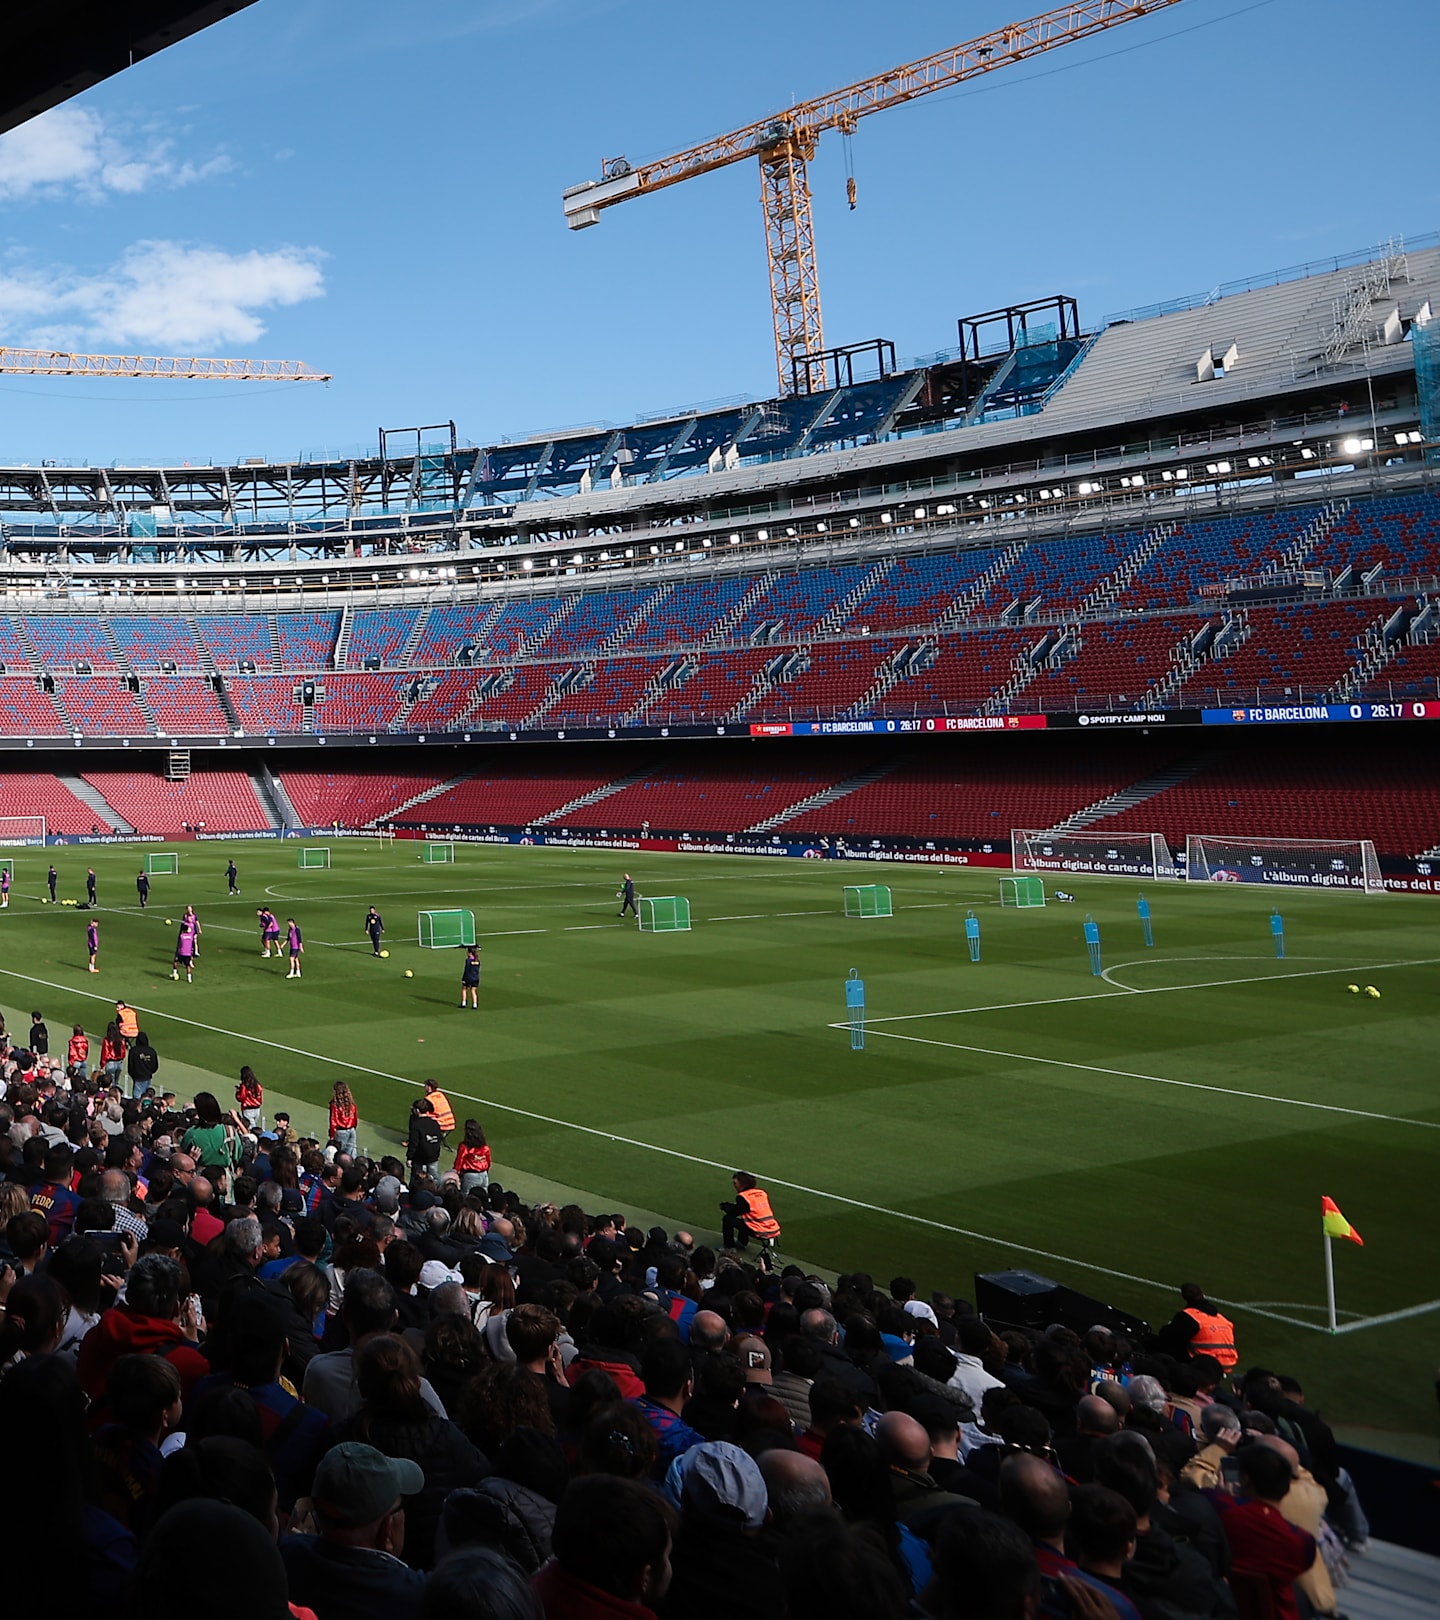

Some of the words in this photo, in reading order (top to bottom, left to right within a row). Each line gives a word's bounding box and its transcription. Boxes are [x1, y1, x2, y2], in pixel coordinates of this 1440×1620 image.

[1090, 715, 1122, 724] SPOTIFY
[1123, 714, 1146, 722] CAMP
[1147, 714, 1165, 722] NOU
[1249, 709, 1263, 721] FC
[1265, 706, 1329, 720] BARCELONA
[1350, 705, 1362, 718] 0
[1371, 704, 1403, 718] 26:17
[1413, 703, 1426, 717] 0
[822, 723, 832, 732] FC
[833, 721, 874, 732] BARCELONA
[887, 720, 895, 731] 0
[900, 720, 921, 731] 26:17
[926, 719, 935, 730] 0
[946, 719, 956, 729] FC
[957, 717, 1004, 729] BARCELONA
[568, 838, 585, 846] digital
[678, 843, 703, 851] L'àlbum
[704, 844, 724, 853] digital
[725, 844, 733, 852] de
[734, 845, 755, 853] cartes
[768, 847, 787, 855] Barça
[868, 851, 892, 861] digital
[894, 852, 904, 860] de
[930, 853, 943, 861] del
[944, 854, 968, 864] Barça
[1023, 858, 1060, 868] L'àlbum
[1062, 860, 1092, 871] digital
[1094, 861, 1106, 871] de
[1108, 864, 1138, 873] cartes
[1140, 864, 1153, 874] de
[1157, 865, 1186, 876] Barça
[1263, 871, 1309, 883] L'àlbum
[1311, 873, 1349, 886] digital
[1351, 876, 1365, 886] de
[1369, 878, 1408, 888] cartes
[1411, 878, 1431, 890] del
[31, 1194, 55, 1210] PEDRI
[1091, 1369, 1119, 1384] PEDRI
